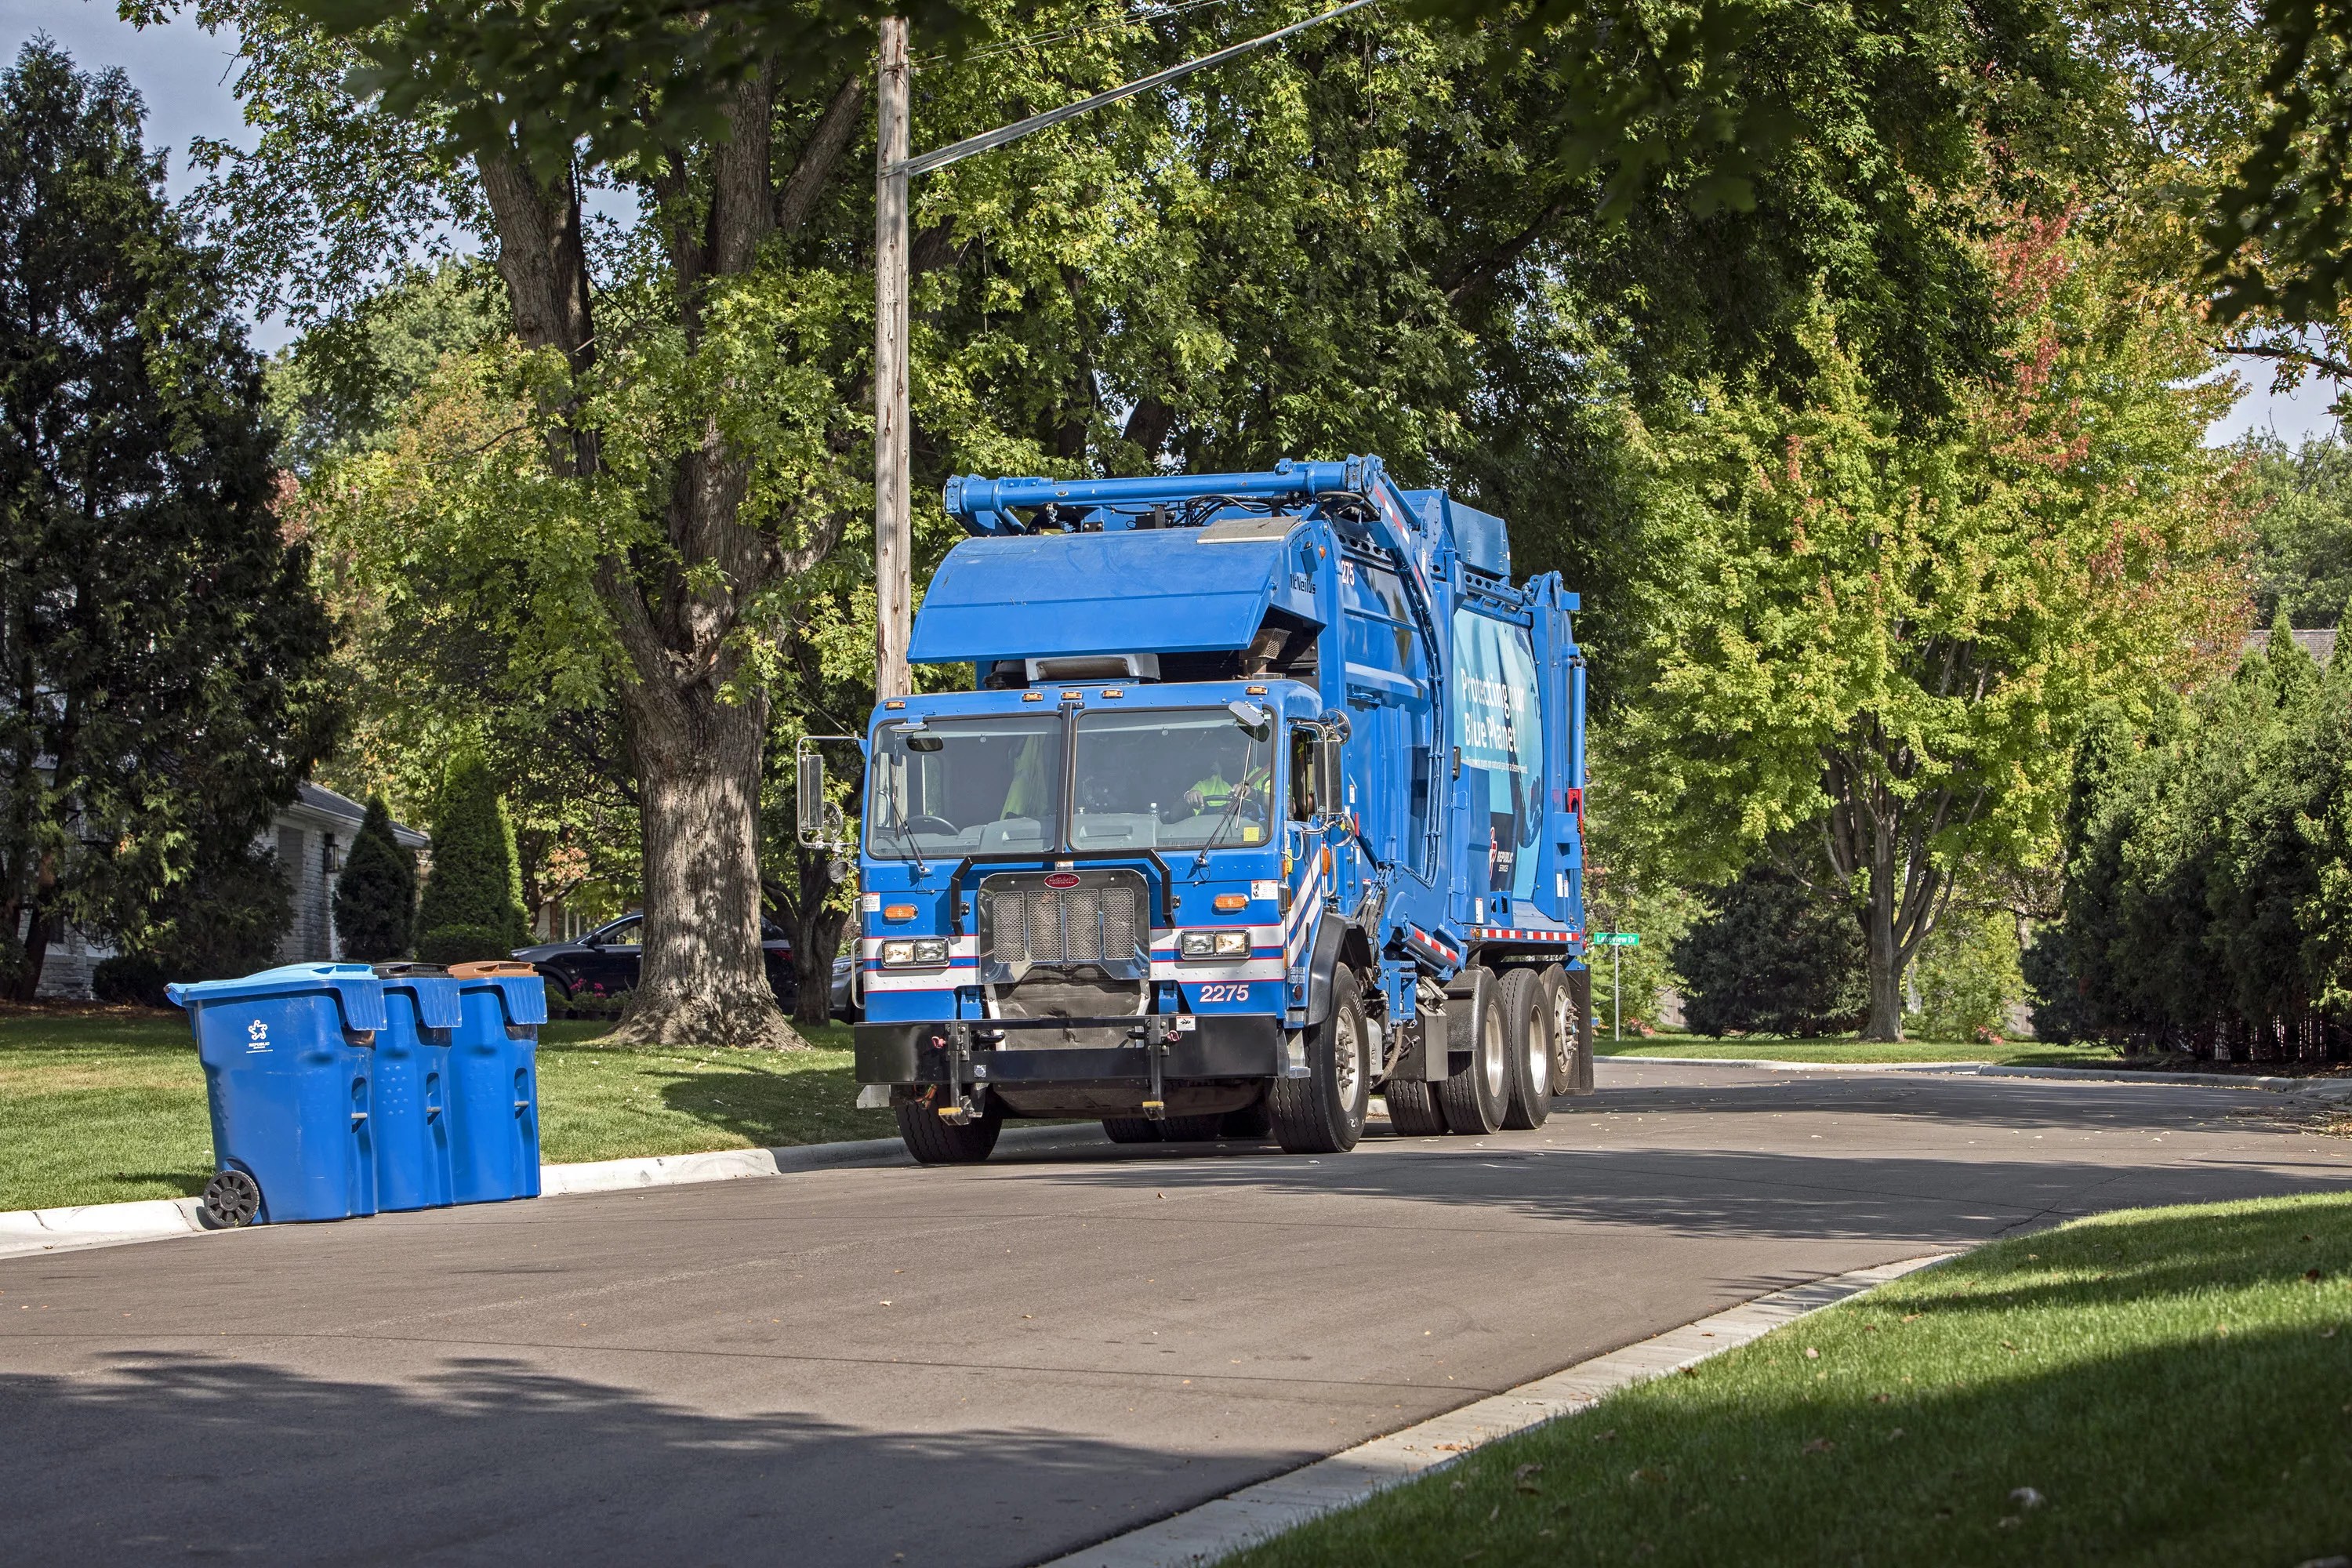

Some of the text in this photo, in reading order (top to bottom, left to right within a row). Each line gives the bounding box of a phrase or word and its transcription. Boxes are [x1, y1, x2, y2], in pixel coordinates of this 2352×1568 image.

[1290, 573, 1316, 595] McNeilus
[1341, 560, 1356, 586] 275
[1461, 668, 1525, 719] Protecting our
[1465, 712, 1487, 748] Blue
[1496, 851, 1514, 863] REPUBLIC
[1596, 935, 1636, 944] Lakeview Dr
[1200, 985, 1249, 1003] 2275
